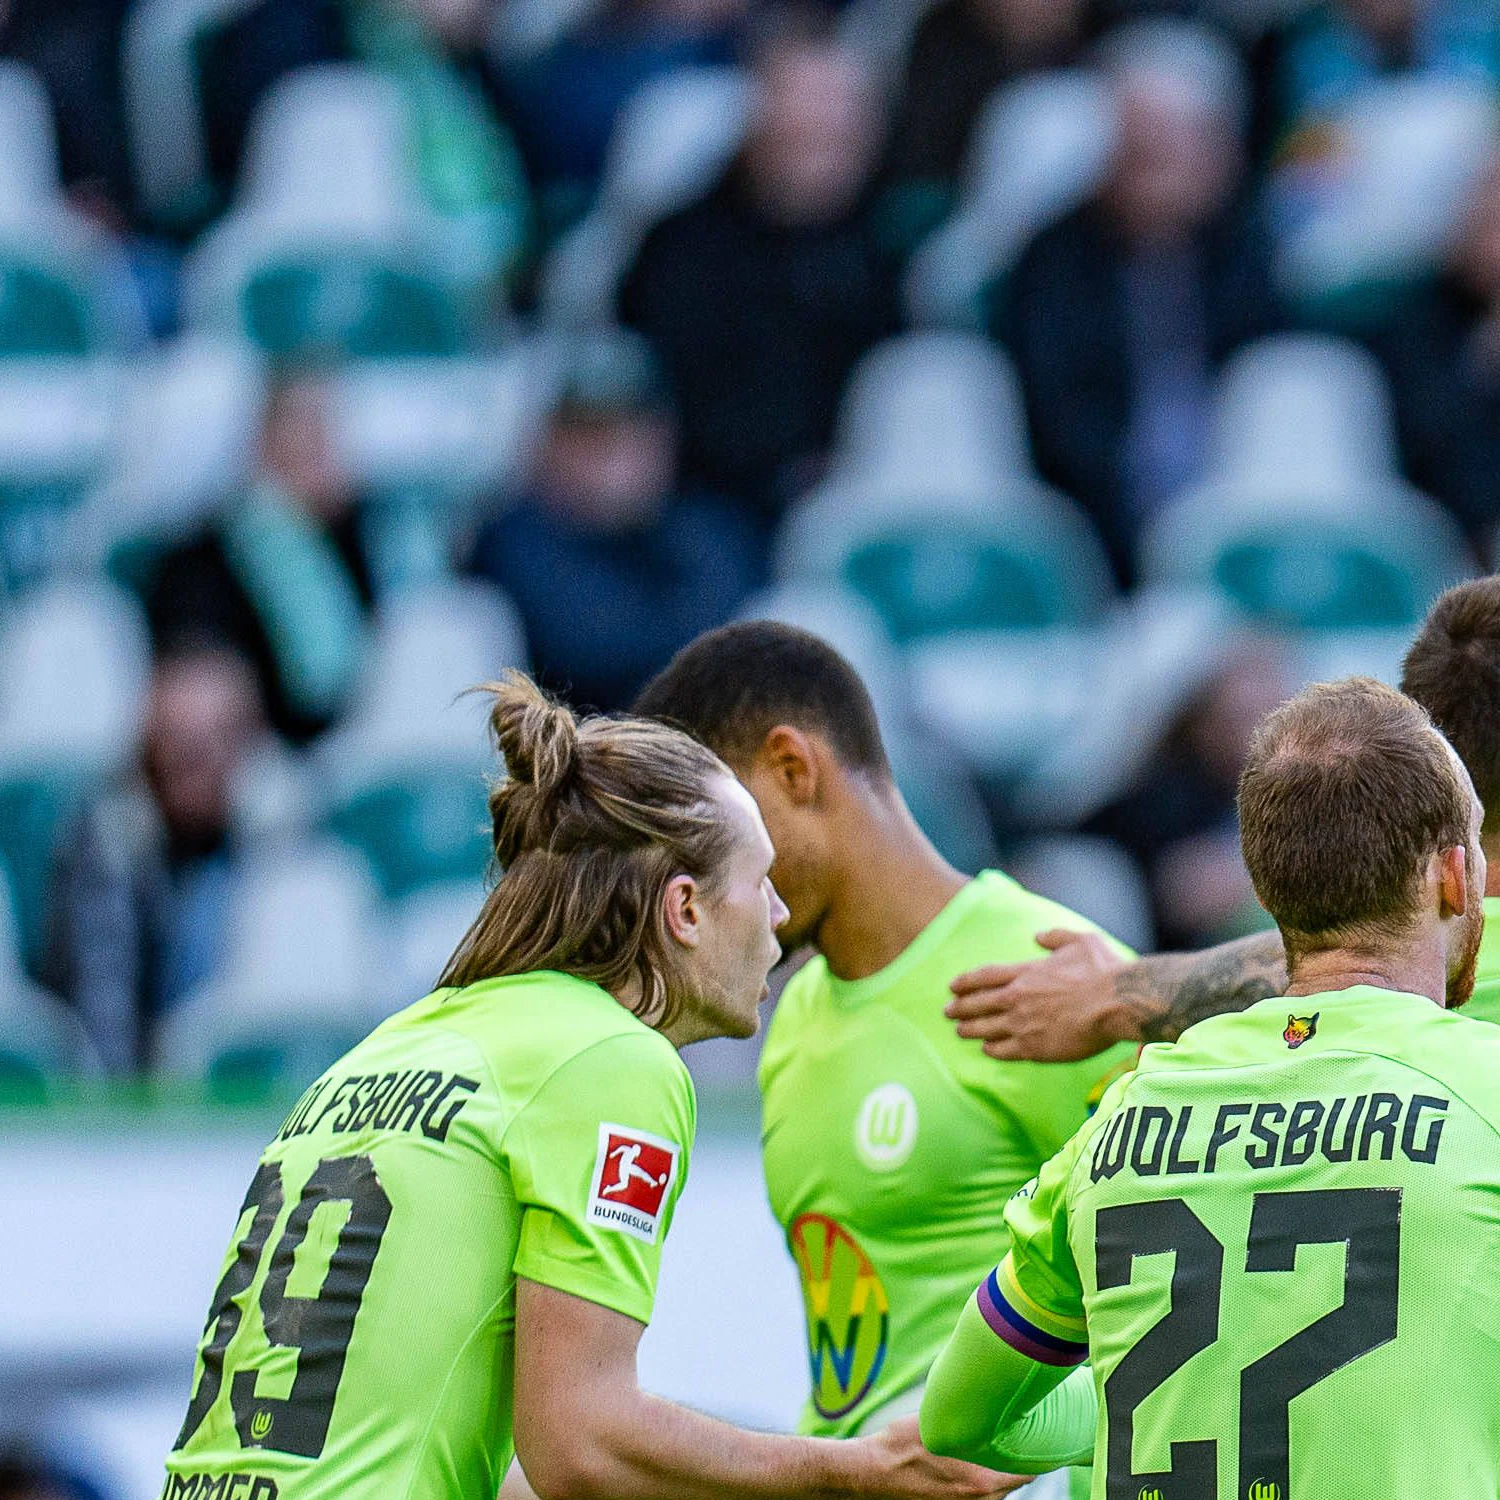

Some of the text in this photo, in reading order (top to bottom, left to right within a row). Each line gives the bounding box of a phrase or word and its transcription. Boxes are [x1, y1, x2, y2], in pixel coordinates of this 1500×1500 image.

[277, 1070, 482, 1144] OLFSBURG
[1091, 1092, 1449, 1185] WOLFSBURG
[594, 1205, 654, 1235] BUNDESLIGA
